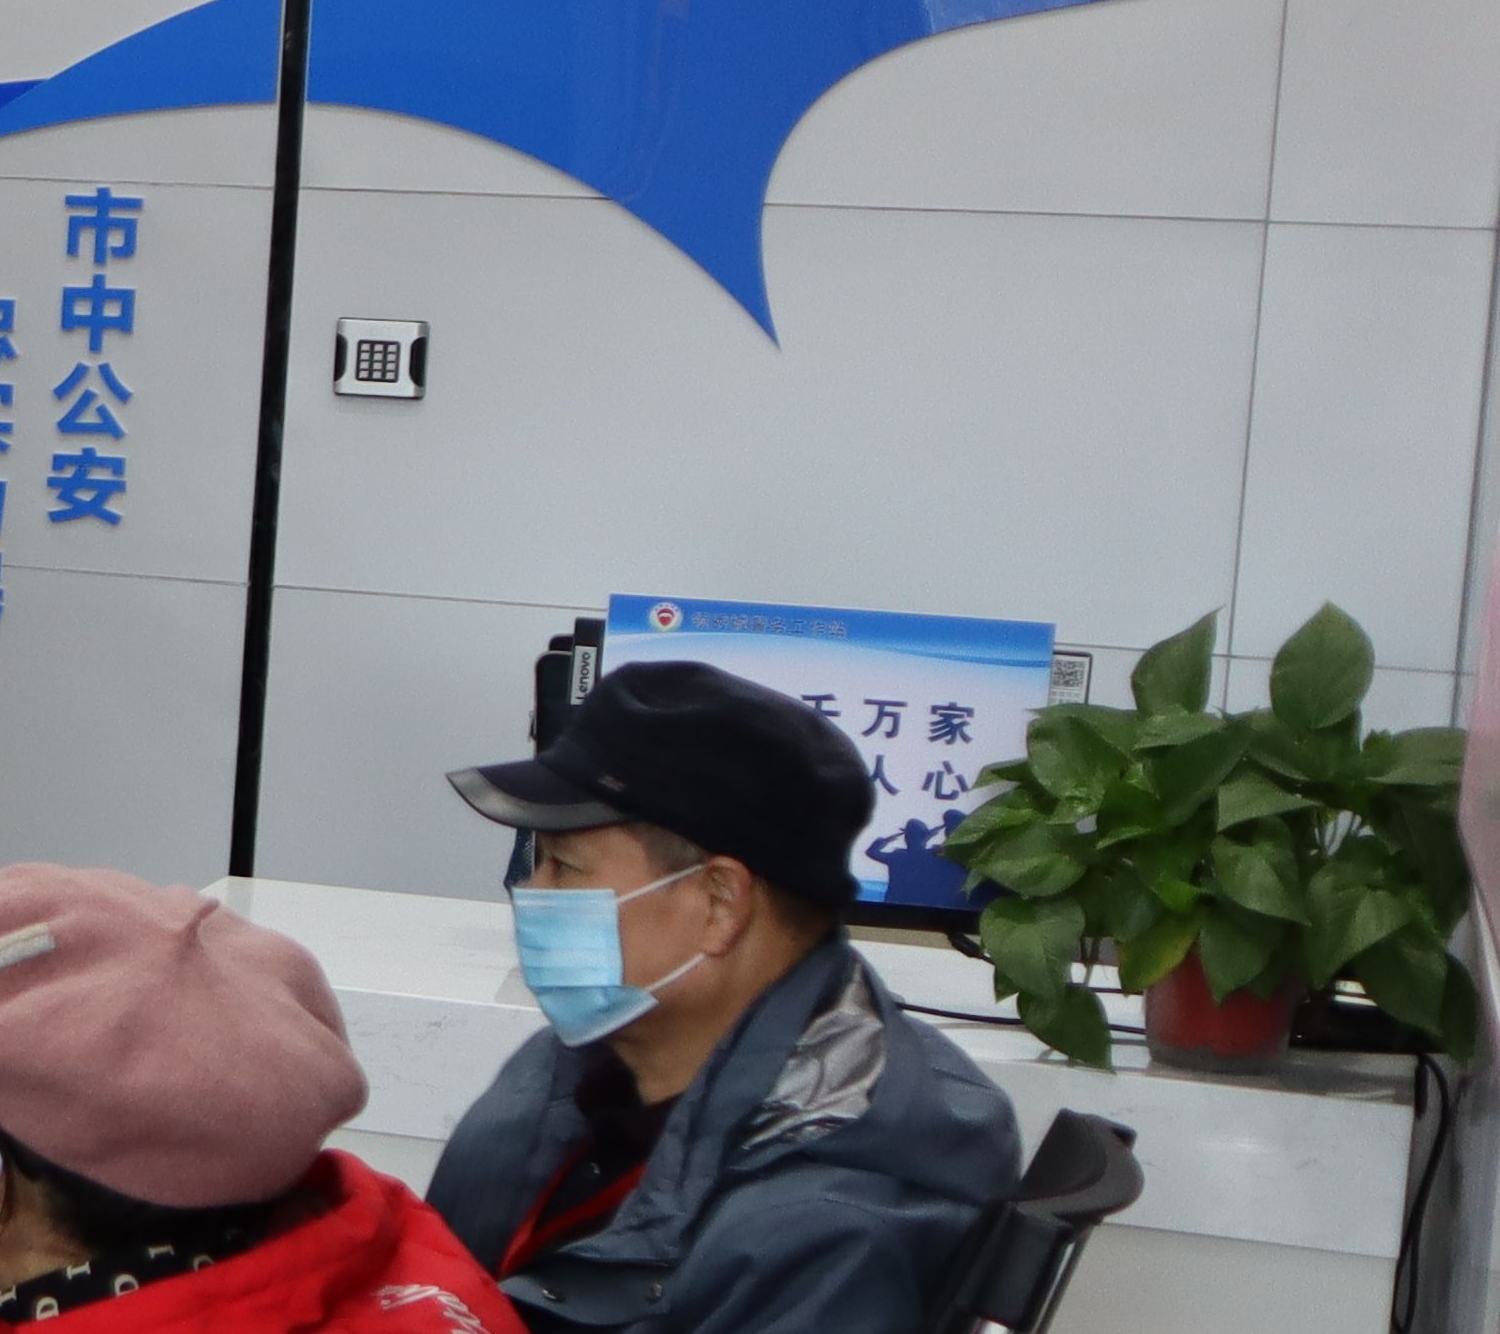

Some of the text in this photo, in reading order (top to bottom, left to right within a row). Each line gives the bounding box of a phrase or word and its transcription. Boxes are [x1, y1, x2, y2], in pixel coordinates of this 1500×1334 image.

[46, 187, 144, 526] 市中公安
[575, 652, 591, 699] Lenovo
